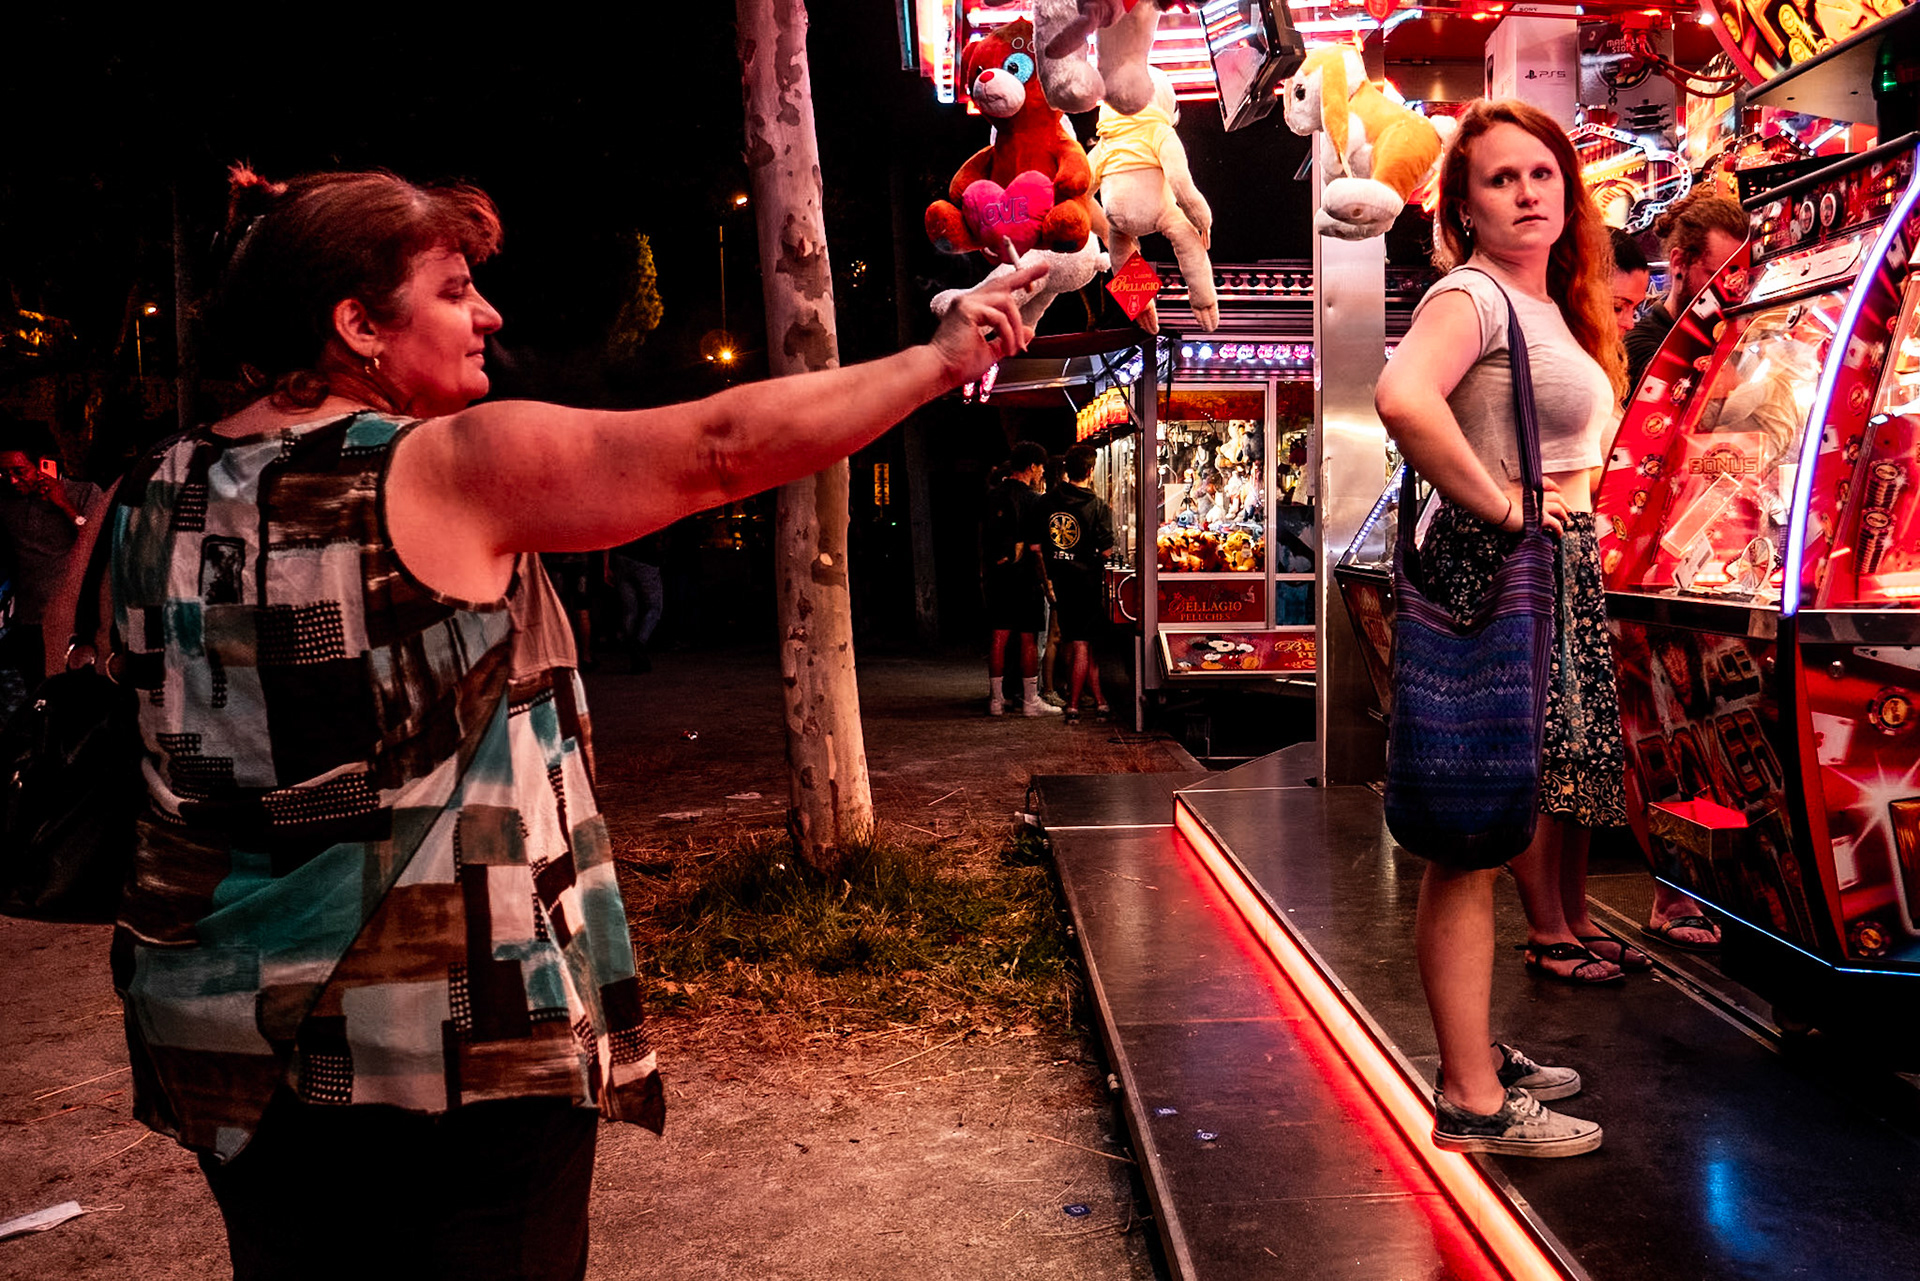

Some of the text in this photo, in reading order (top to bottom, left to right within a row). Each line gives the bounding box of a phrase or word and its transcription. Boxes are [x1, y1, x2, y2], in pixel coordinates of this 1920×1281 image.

[1539, 70, 1566, 78] PS5
[1627, 165, 1646, 175] CITY
[975, 196, 1030, 227] OVE
[1111, 275, 1160, 292] BELLAGIO
[1689, 457, 1759, 475] BONUS
[1168, 597, 1242, 616] BELLAGIO
[1180, 612, 1231, 621] PELUCHES
